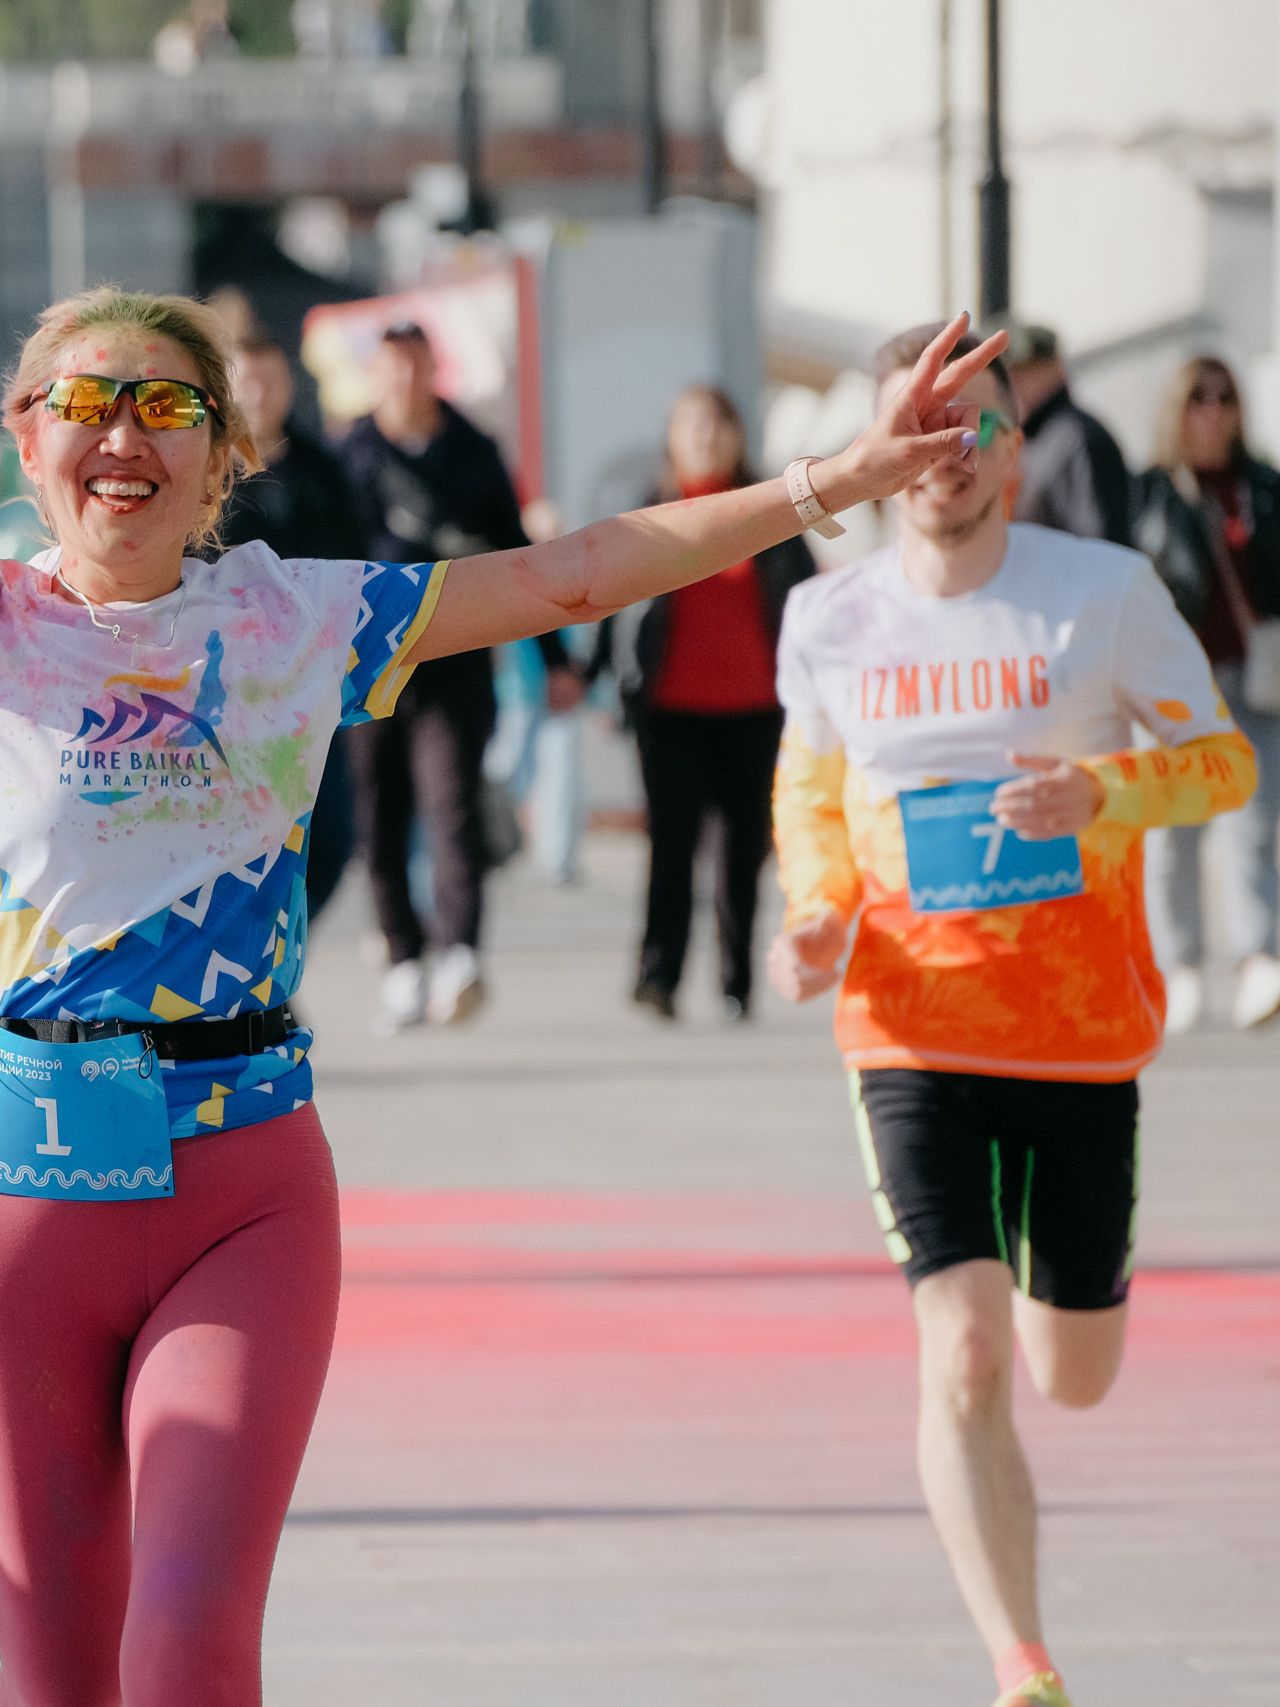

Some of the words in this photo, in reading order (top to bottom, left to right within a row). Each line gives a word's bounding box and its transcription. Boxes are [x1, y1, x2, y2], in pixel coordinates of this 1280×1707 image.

[60, 749, 121, 769] PURE
[130, 752, 211, 770] BAIKAL
[59, 773, 211, 787] MARATHON
[971, 824, 1007, 875] 7
[17, 1054, 63, 1071] РЕЧНОЙ
[25, 1068, 52, 1081] 2023
[34, 1096, 73, 1157] 1
